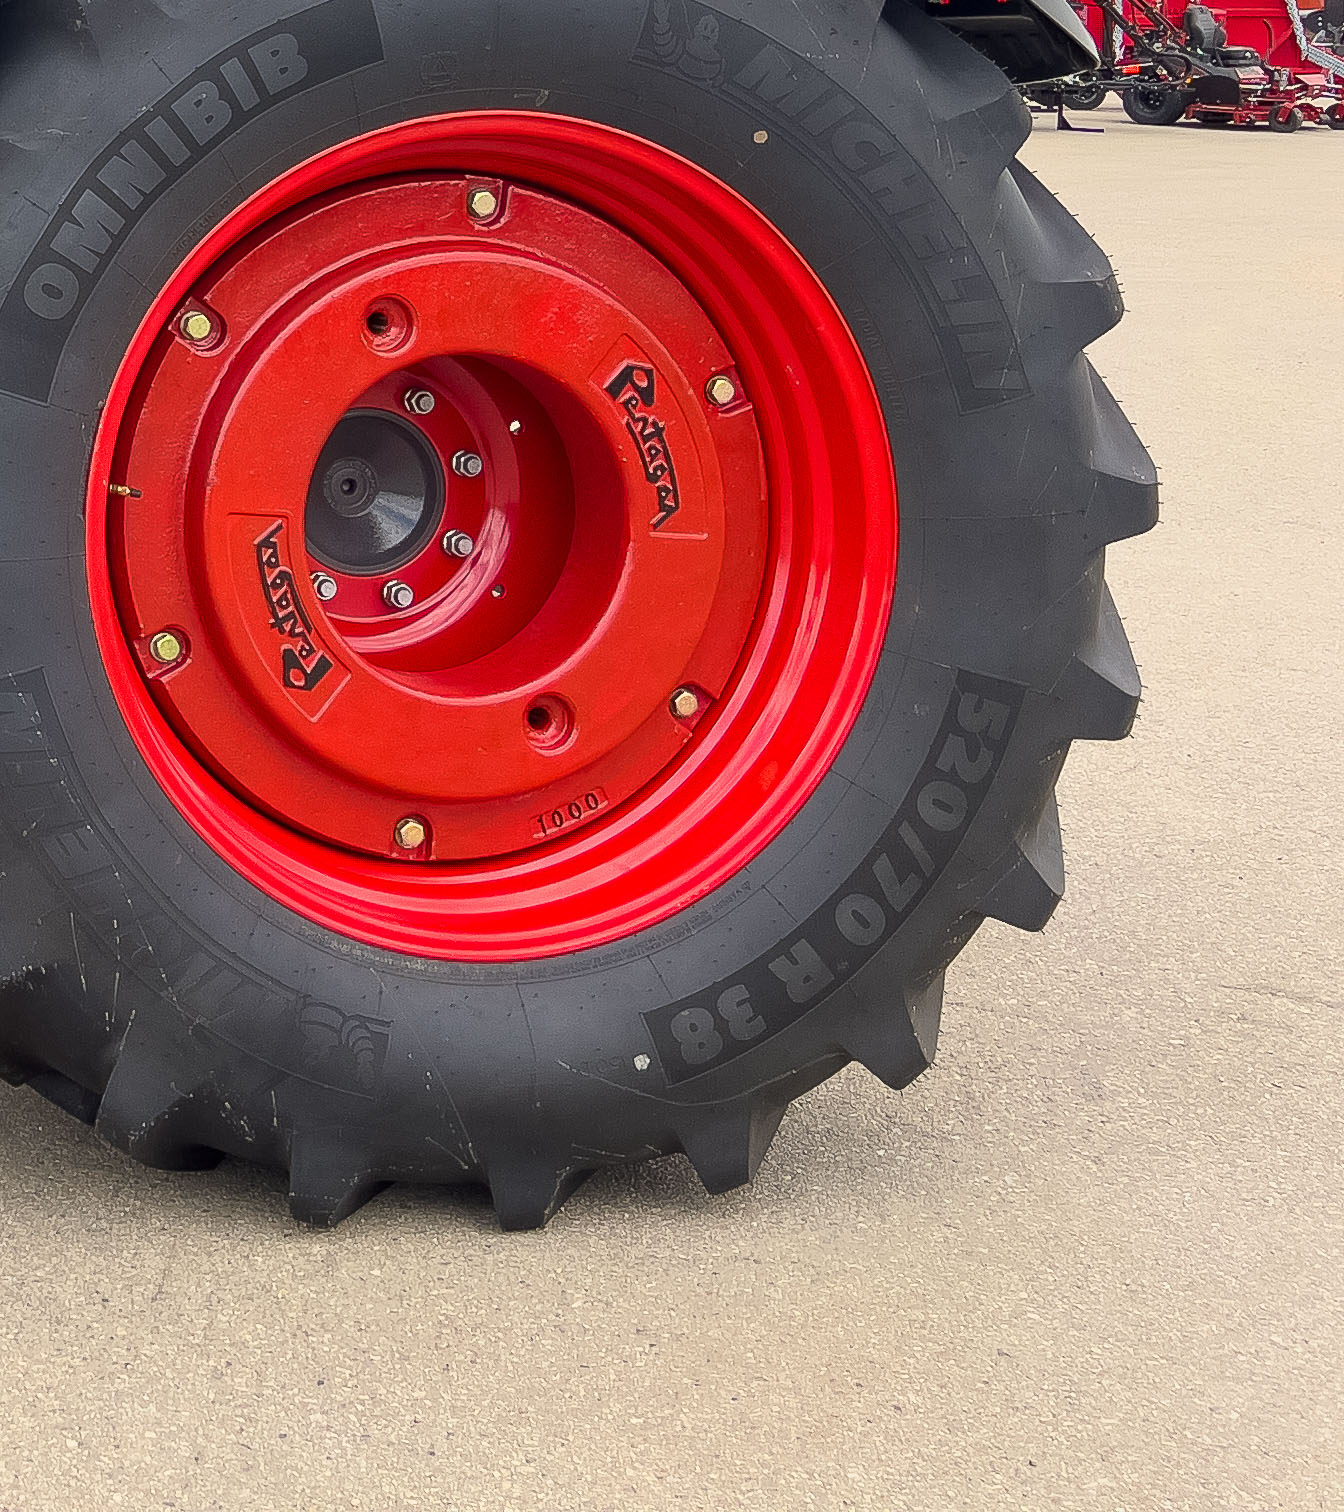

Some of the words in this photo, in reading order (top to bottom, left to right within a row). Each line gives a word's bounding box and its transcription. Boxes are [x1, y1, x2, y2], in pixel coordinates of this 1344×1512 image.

[23, 32, 310, 321] OMNIBIB
[732, 42, 1030, 392] MICHELIN
[604, 360, 681, 531] Pentagon
[253, 520, 333, 691] Pentagon
[536, 791, 599, 837] 1000
[834, 691, 1009, 947] 520/70
[670, 984, 767, 1065] 38
[768, 938, 836, 1004] R
